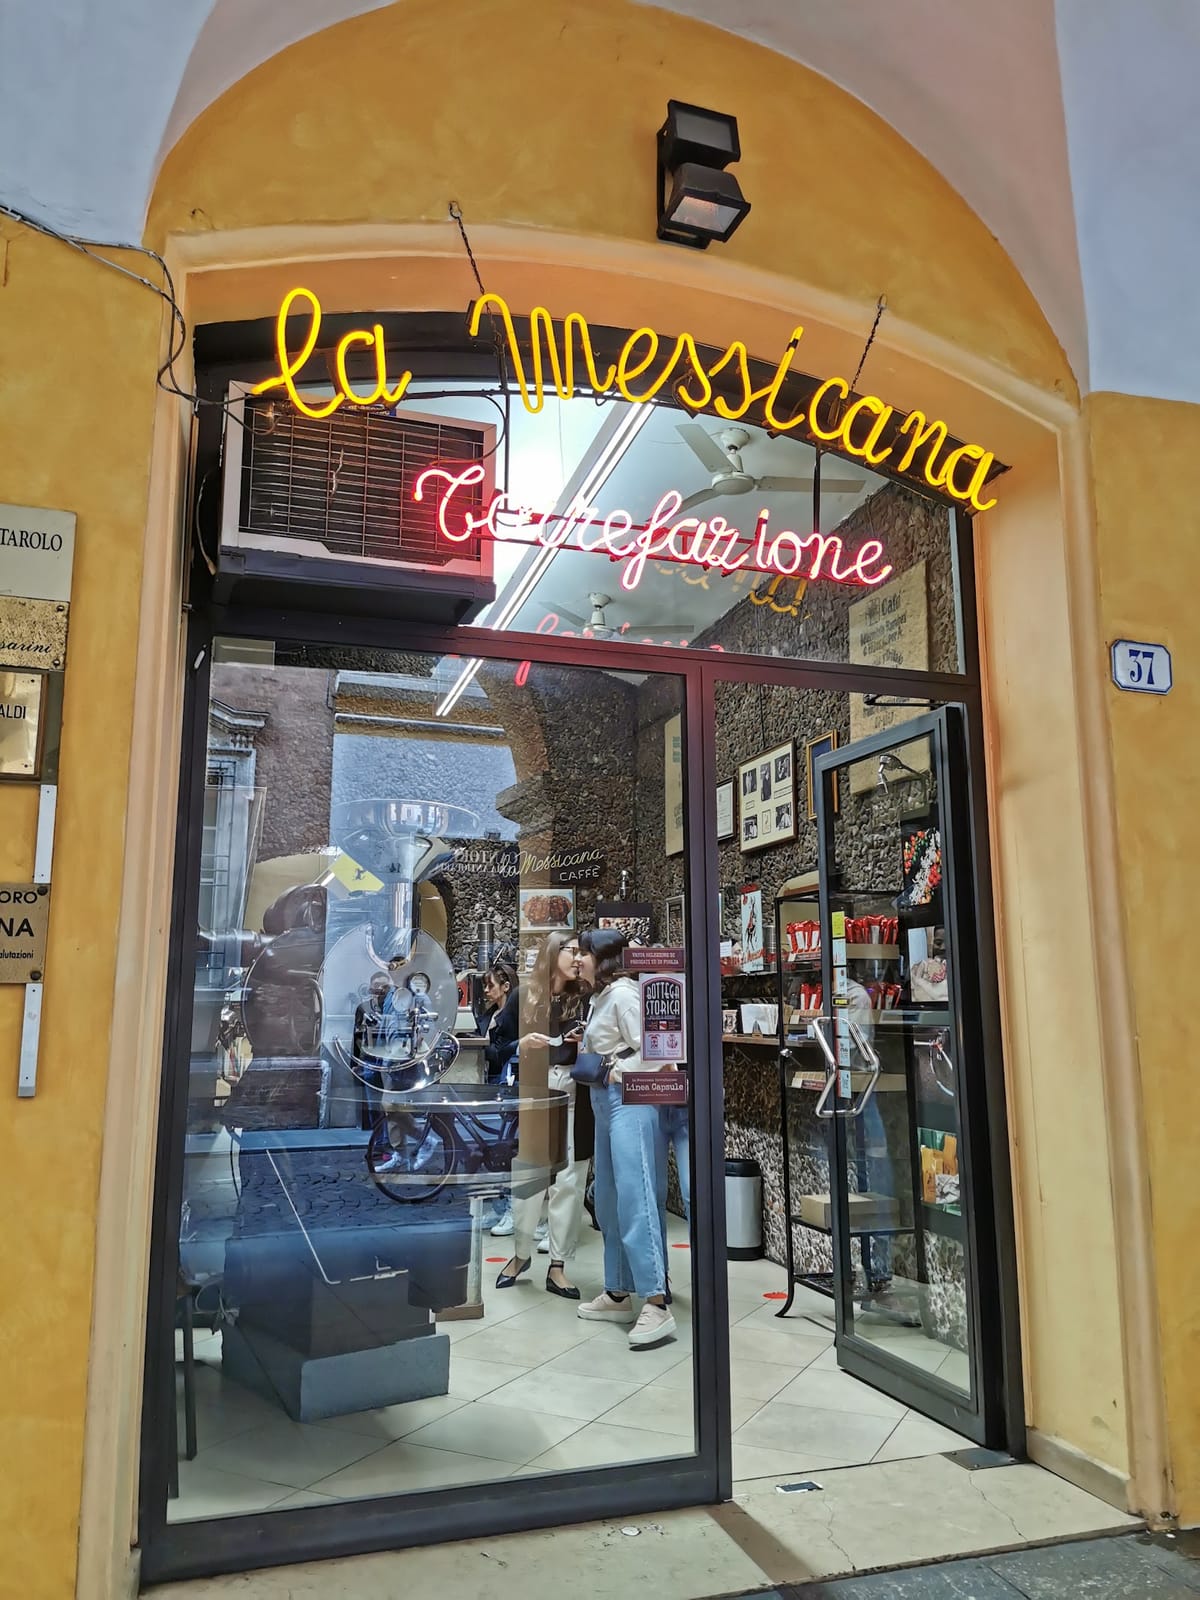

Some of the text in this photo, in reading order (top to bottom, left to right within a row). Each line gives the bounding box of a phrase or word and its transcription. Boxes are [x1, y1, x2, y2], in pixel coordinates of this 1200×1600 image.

[251, 287, 412, 418] la
[0, 528, 63, 552] TAROLO
[1128, 649, 1155, 685] 37
[0, 891, 37, 904] ORO
[647, 982, 680, 1000] BOTTEGA
[646, 1000, 681, 1016] STORICA
[625, 1082, 684, 1093] Linea Capsule
